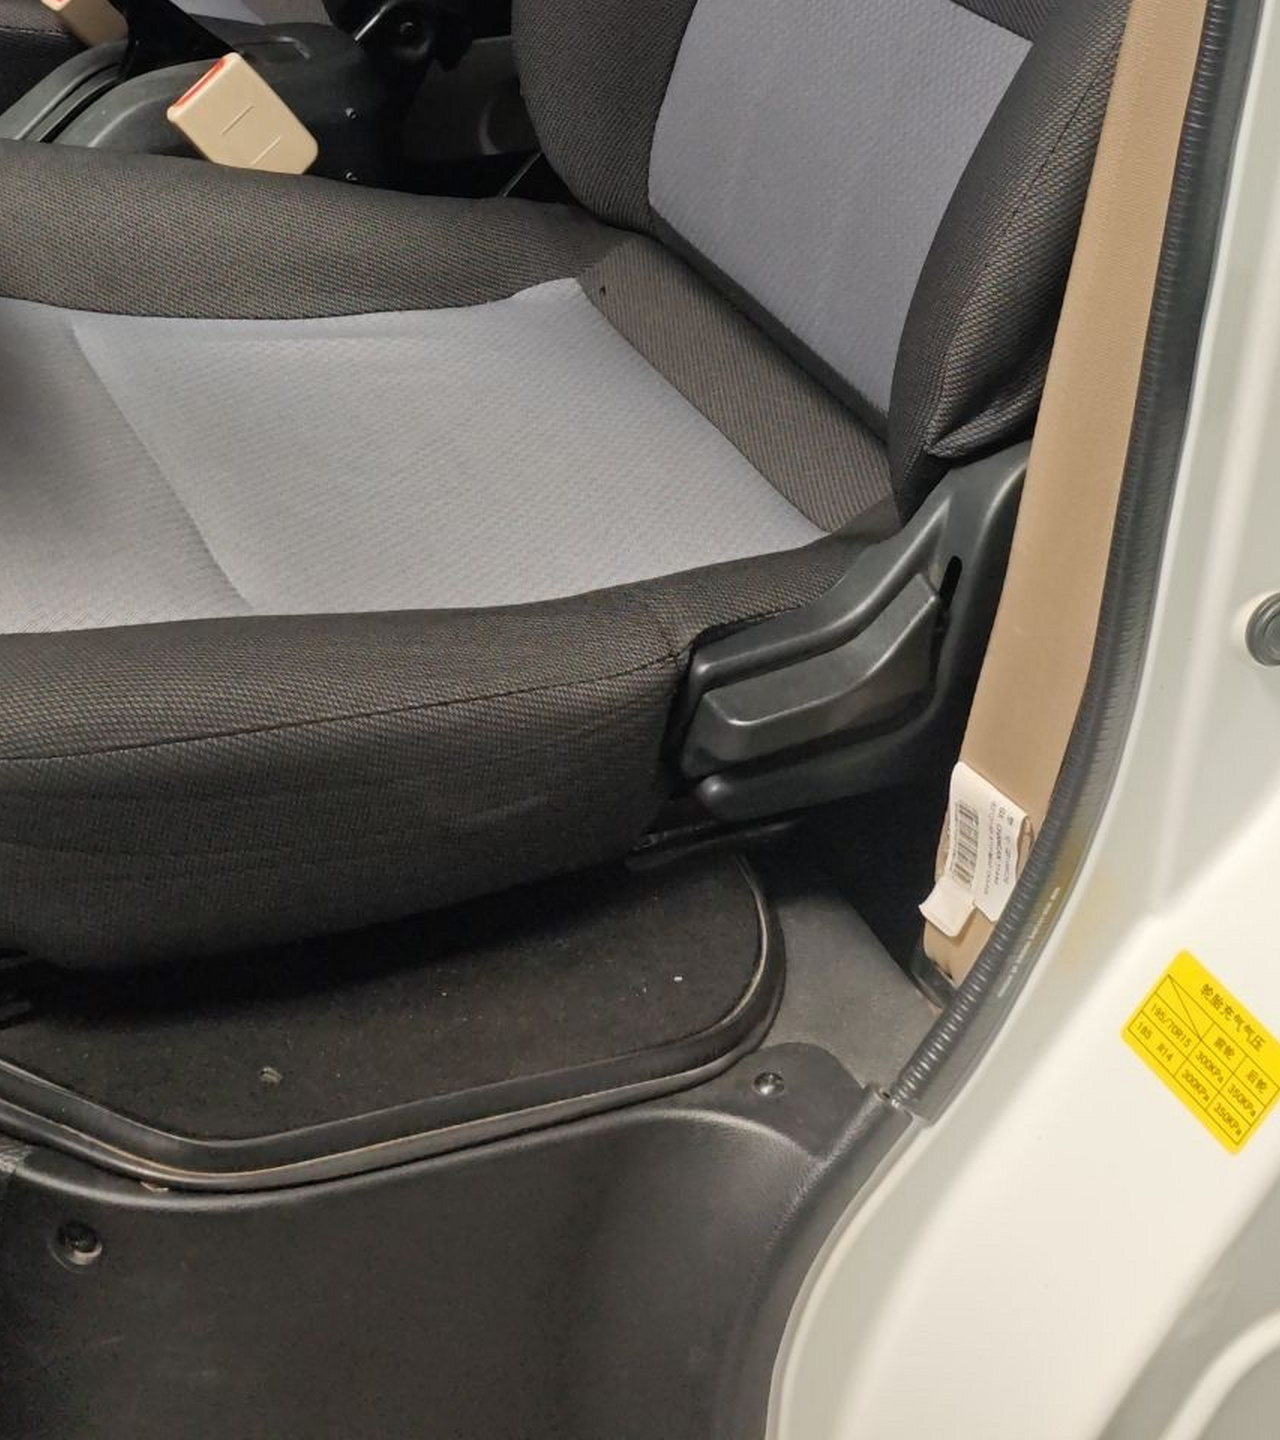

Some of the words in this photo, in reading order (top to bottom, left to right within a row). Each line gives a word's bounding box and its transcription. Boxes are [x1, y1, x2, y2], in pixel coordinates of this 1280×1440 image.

[1152, 1004, 1192, 1048] 195/70R15
[1201, 984, 1265, 1051] 轮胎充气气压
[1137, 1022, 1153, 1040] 185
[1157, 1043, 1173, 1061] R14
[1214, 1037, 1235, 1060] 前轮
[1195, 1051, 1224, 1083] 300KPa
[1246, 1070, 1268, 1094] 后轮
[1227, 1084, 1256, 1117] 350KPa
[1214, 1103, 1242, 1136] 350KPa
